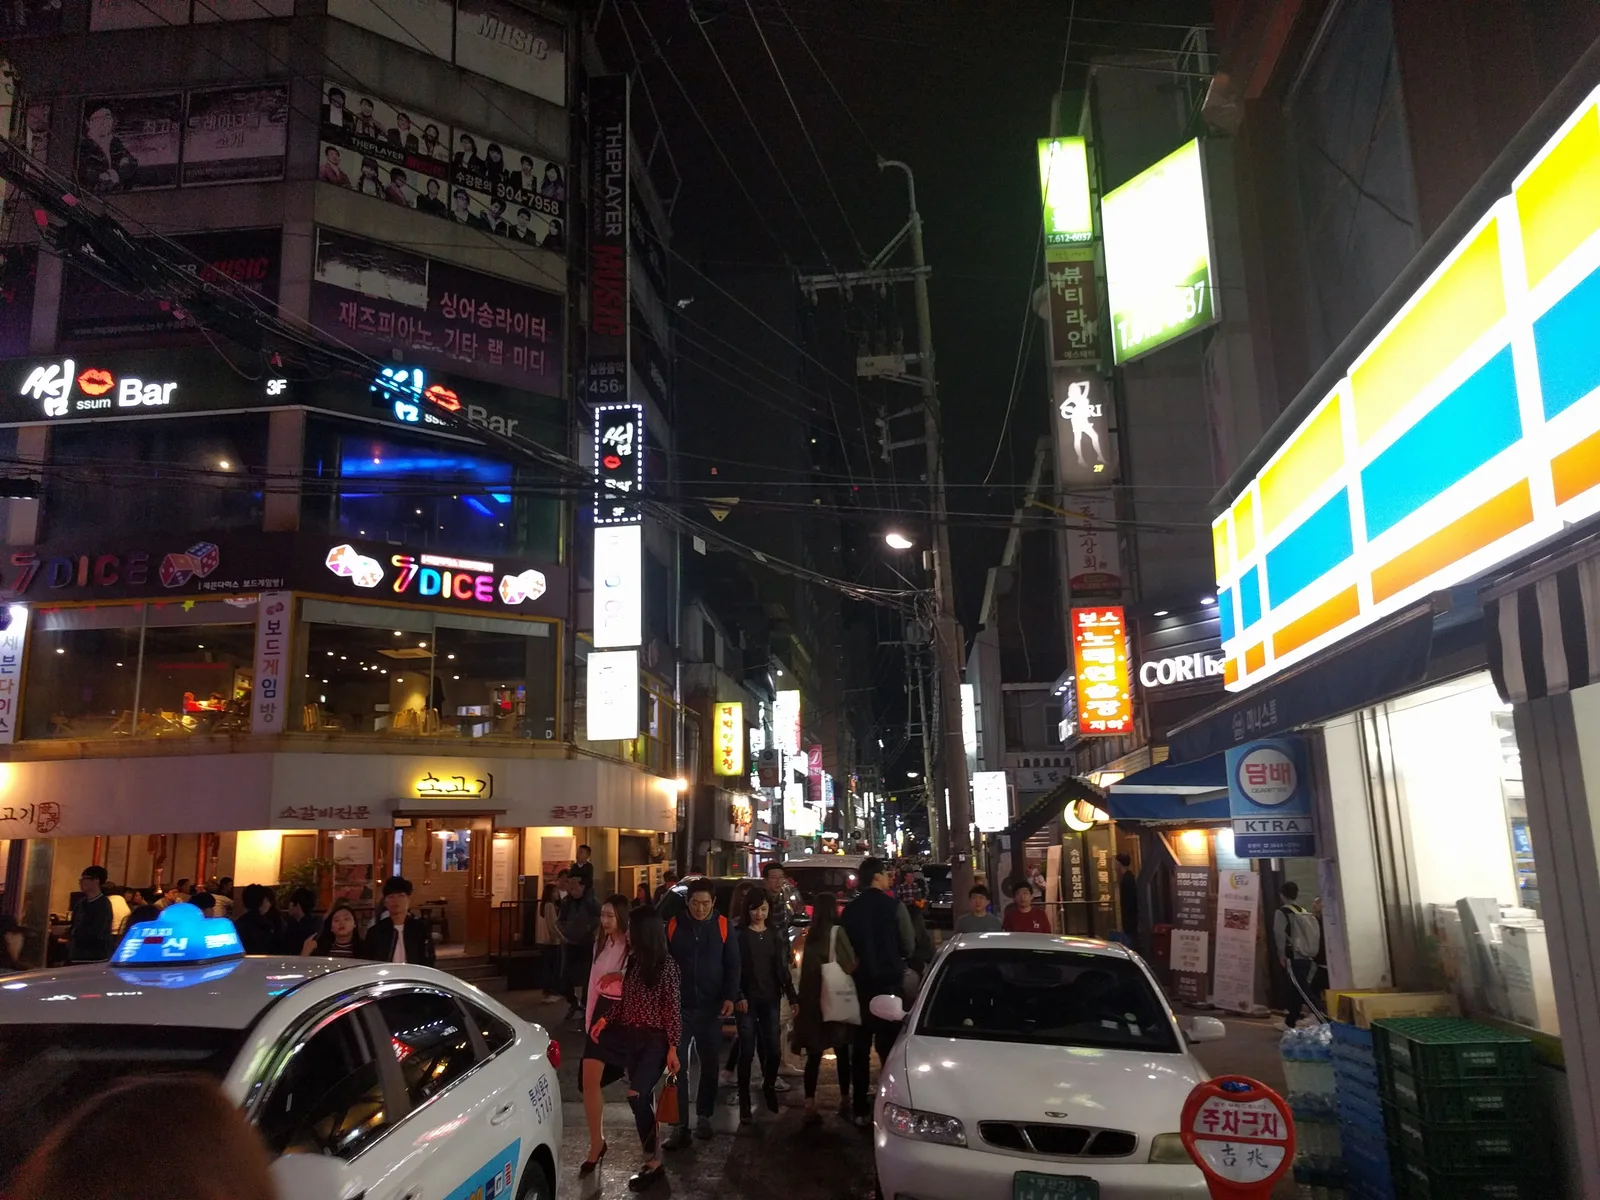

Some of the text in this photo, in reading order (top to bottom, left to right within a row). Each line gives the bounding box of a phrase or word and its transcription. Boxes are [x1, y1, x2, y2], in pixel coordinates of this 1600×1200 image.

[475, 12, 549, 61] MUSIC
[351, 137, 404, 161] THEPLAYER
[605, 122, 622, 237] THEPLAYER
[497, 183, 561, 216] 904-7958
[592, 244, 624, 336] MUSIC
[440, 291, 547, 343] 싱어송라이터
[1064, 266, 1086, 348] 뷰티라인
[339, 301, 434, 344] 재즈피아노
[445, 328, 479, 360] 기타
[118, 378, 177, 407] Bar
[267, 379, 287, 395] 3F
[76, 399, 111, 410] ssum
[467, 404, 518, 437] Bar
[50, 553, 149, 588] DICE
[420, 568, 494, 602] DICE
[1079, 612, 1121, 628] 보스
[258, 619, 285, 724] 보드게임방
[1140, 653, 1205, 688] CORI
[417, 771, 494, 799] 소고기
[1246, 763, 1292, 786] 담배
[278, 804, 369, 821] 소갈비전문
[551, 804, 594, 820] 골목집
[1246, 821, 1300, 833] KTRA
